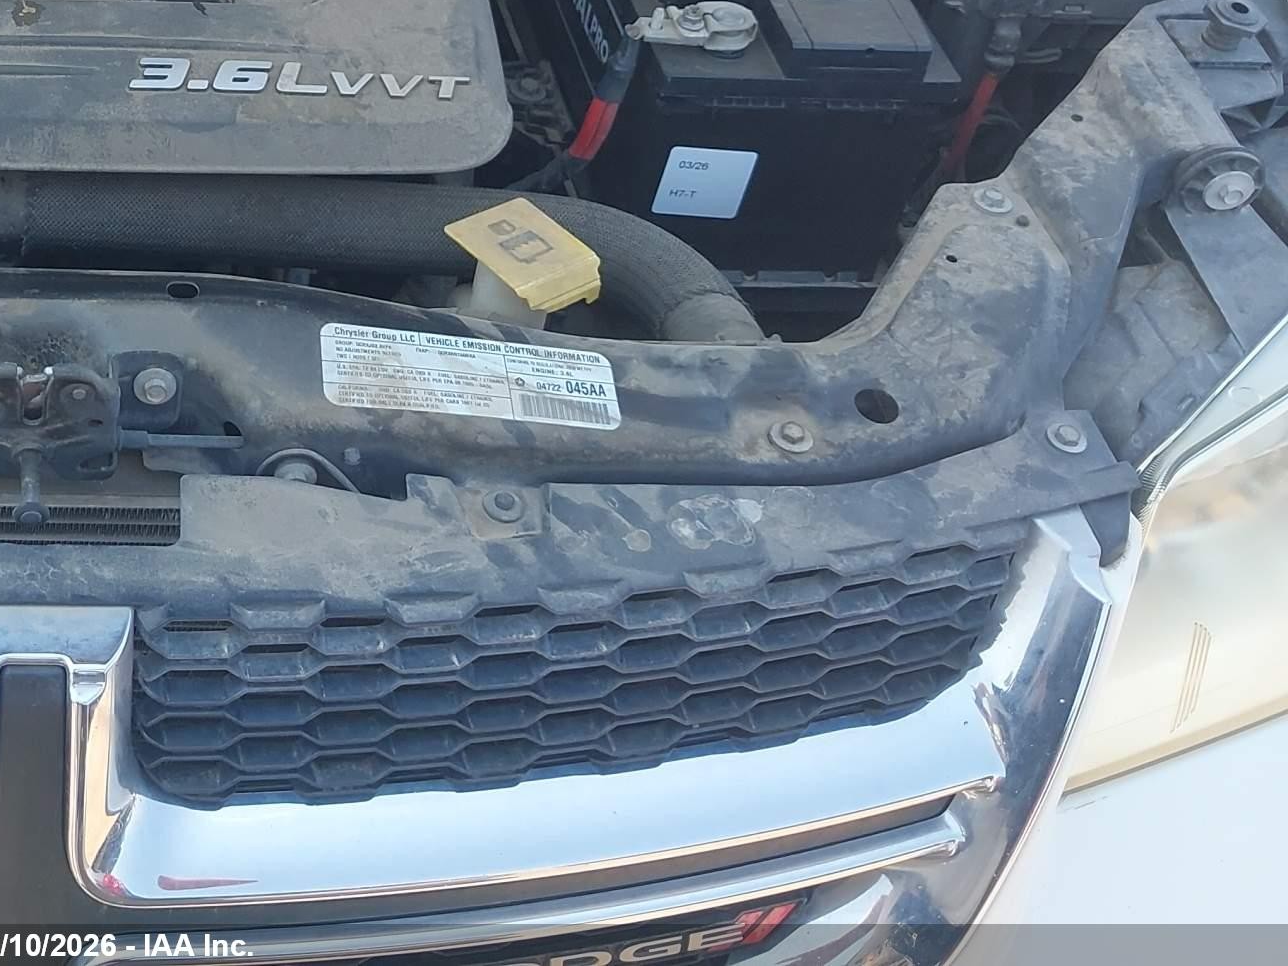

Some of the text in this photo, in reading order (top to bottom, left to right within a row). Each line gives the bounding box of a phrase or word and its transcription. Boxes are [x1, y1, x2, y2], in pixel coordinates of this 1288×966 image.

[678, 160, 710, 171] 03/26
[334, 326, 416, 343] Chrysler Group LLC
[425, 336, 460, 348] VEHICLE
[462, 338, 502, 353] EMISSION
[504, 342, 542, 358] CONTROL
[544, 348, 601, 364] INFORMATION
[536, 380, 607, 397] 04722 045AA
